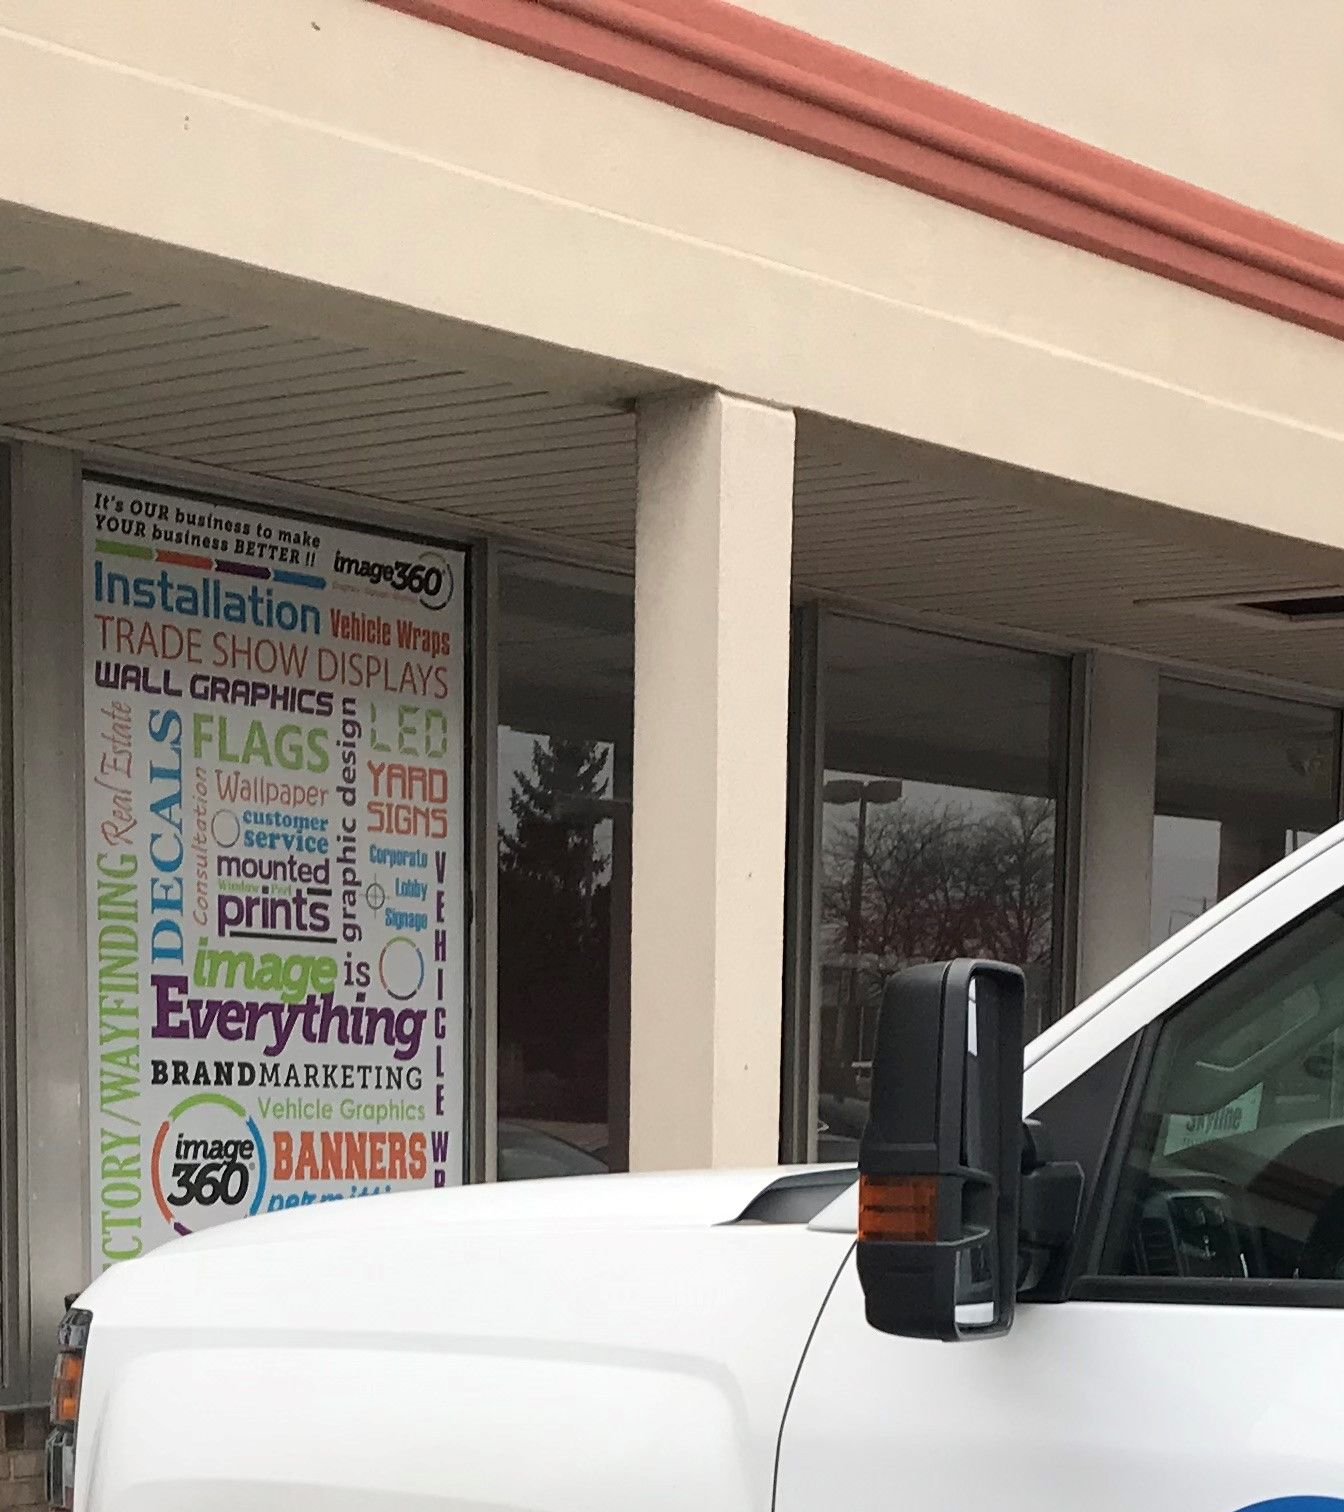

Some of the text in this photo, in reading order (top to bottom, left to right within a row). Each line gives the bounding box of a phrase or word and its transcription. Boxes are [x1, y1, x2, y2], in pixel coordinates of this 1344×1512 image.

[94, 493, 321, 551] It's OUR business to make
[95, 514, 146, 538] YOUR
[152, 526, 229, 553] business
[233, 538, 300, 568] BETTER
[94, 560, 321, 635] Installation
[94, 614, 449, 699] TRADE SHOW DISPLAYS
[330, 608, 450, 659] Vehicle Wraps
[94, 660, 334, 716] WALL GRAPHICS
[192, 712, 329, 774] FLAGS
[370, 701, 448, 758] LED
[94, 700, 137, 846] Real Estate
[215, 768, 329, 807] Wallpaper
[367, 760, 448, 804] YARD
[149, 708, 185, 965] DECALS
[242, 809, 329, 832] customer
[244, 829, 329, 854] service
[336, 696, 362, 942] graphic design
[367, 800, 447, 839] SIGNS
[192, 767, 209, 926] Consultation
[217, 855, 330, 885] mounted
[369, 844, 428, 868] Corporate
[218, 888, 330, 937] prints
[395, 877, 428, 902] Lobby
[385, 907, 428, 932] Signage
[193, 937, 370, 1005] image is
[151, 974, 427, 1061] Everything
[258, 1097, 426, 1125] Vehicle Graphics
[175, 1133, 254, 1168] image
[273, 1131, 427, 1181] BANNERS
[167, 1162, 250, 1207] 360
